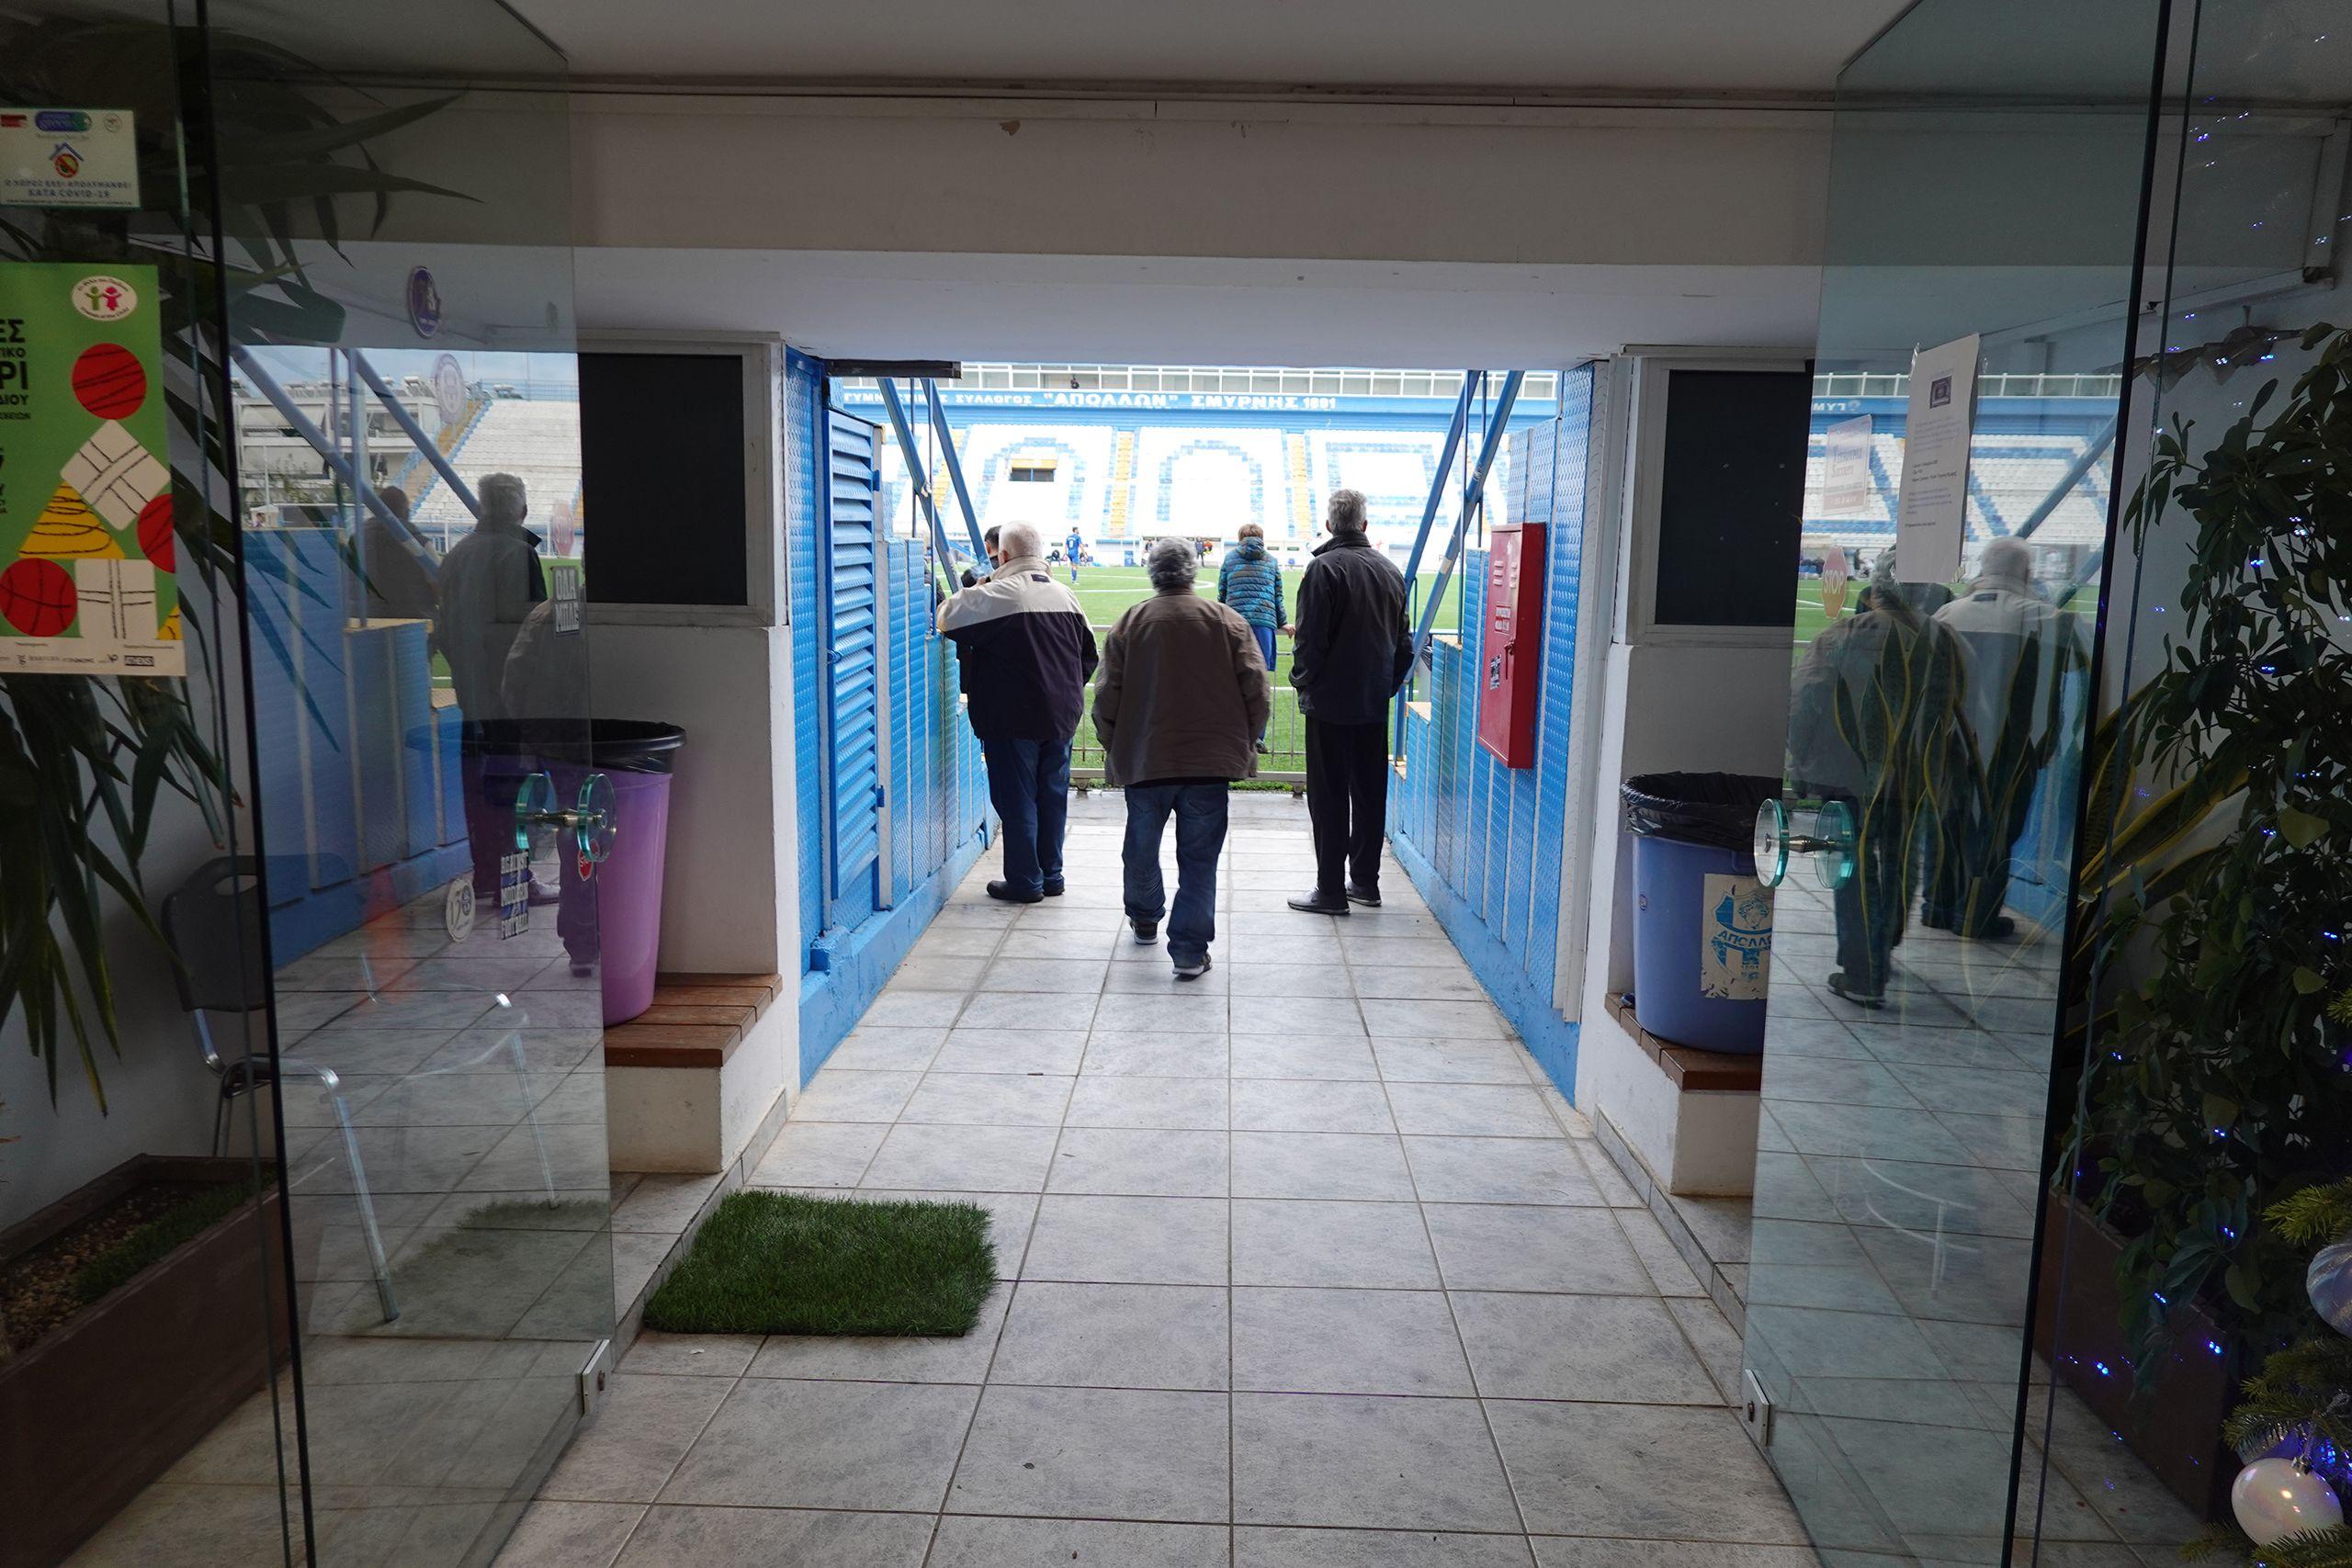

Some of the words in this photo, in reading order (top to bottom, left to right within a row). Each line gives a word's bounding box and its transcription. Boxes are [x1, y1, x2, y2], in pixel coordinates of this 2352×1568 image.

[843, 392, 948, 404] ΓΥΜΝΣΤΙΚΣ
[956, 394, 1033, 405] ΣΥΛΛΟΓΟΣ
[1191, 395, 1297, 409] ΣΜΥΡΝΗΣ
[1823, 570, 1844, 594] STOP
